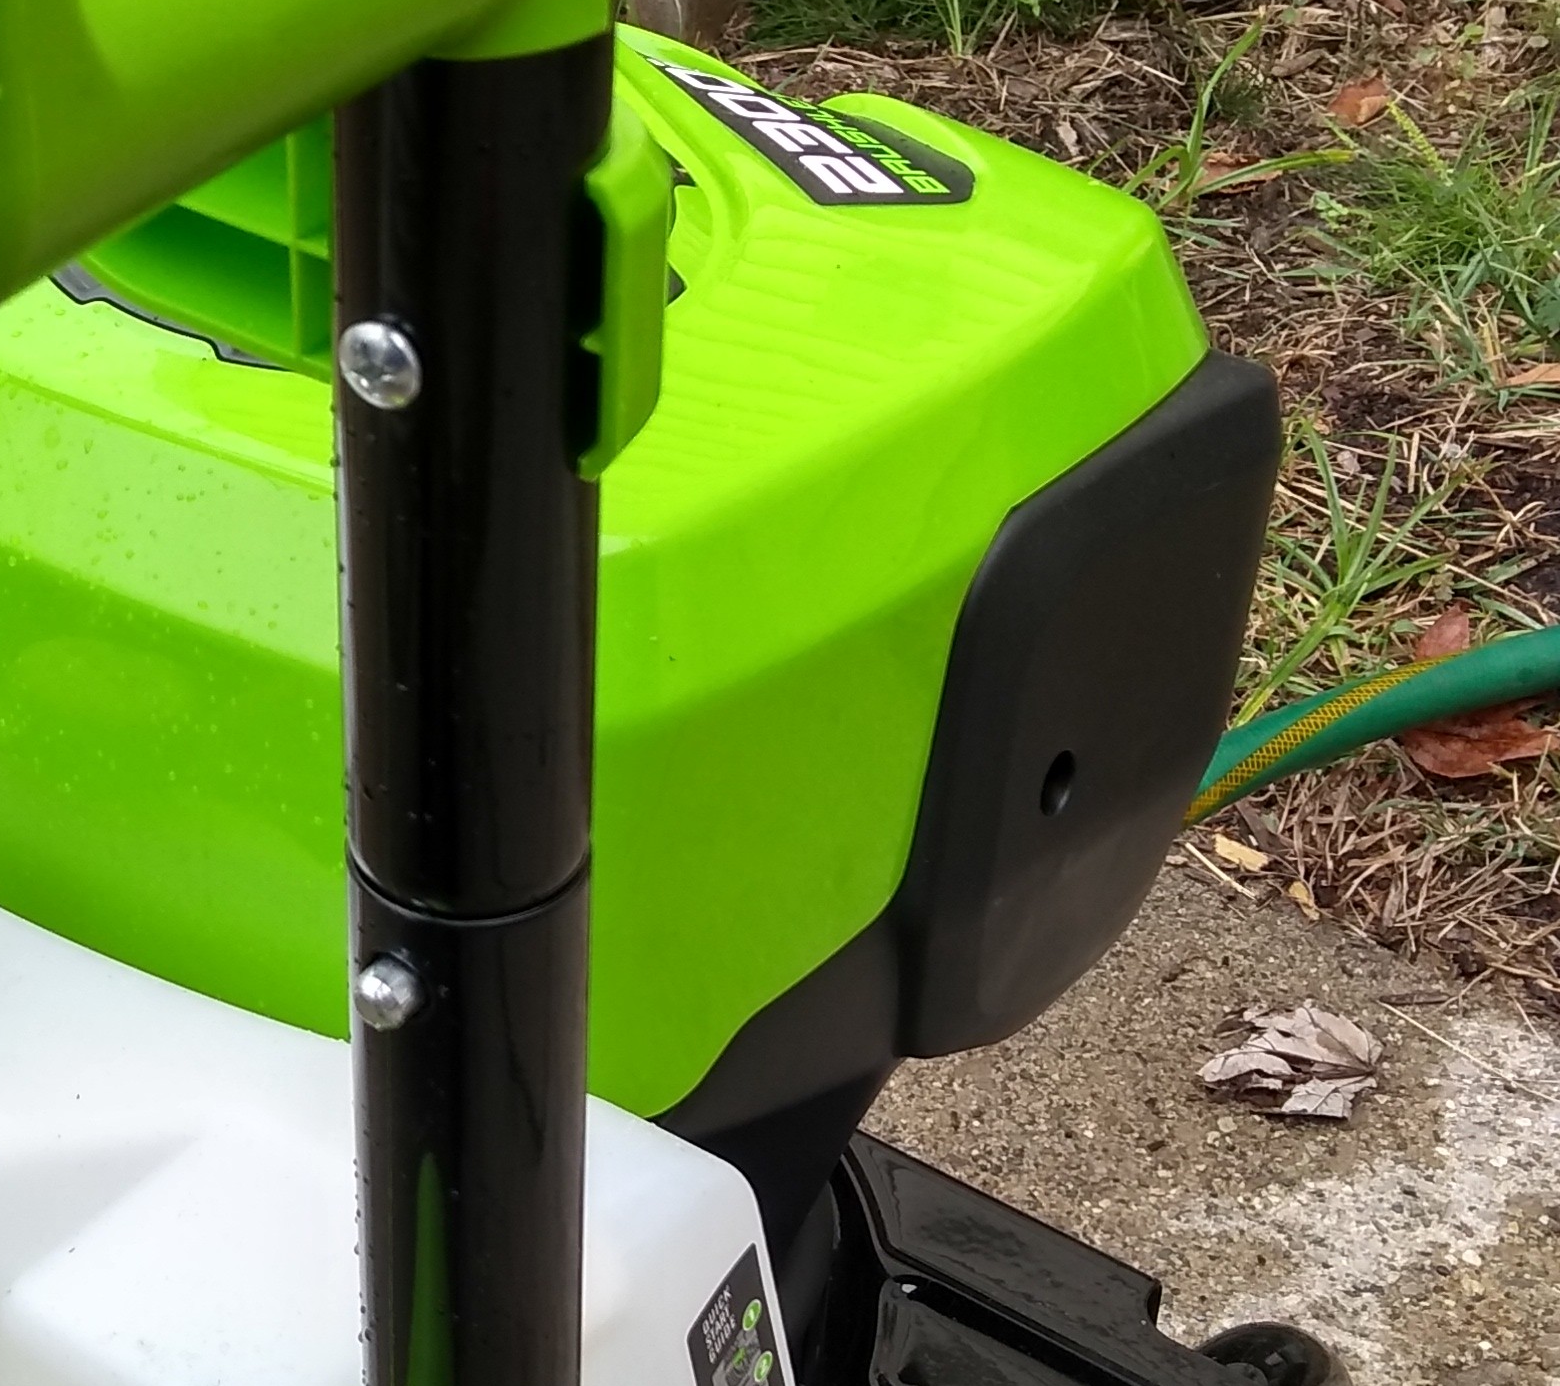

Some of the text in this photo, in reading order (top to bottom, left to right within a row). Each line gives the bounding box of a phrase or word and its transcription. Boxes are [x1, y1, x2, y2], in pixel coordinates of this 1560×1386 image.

[665, 67, 904, 194] 2300
[775, 95, 951, 194] BRUSHLE
[702, 1284, 732, 1335] QUICK
[705, 1301, 731, 1350] START
[708, 1314, 736, 1365] GUIDE
